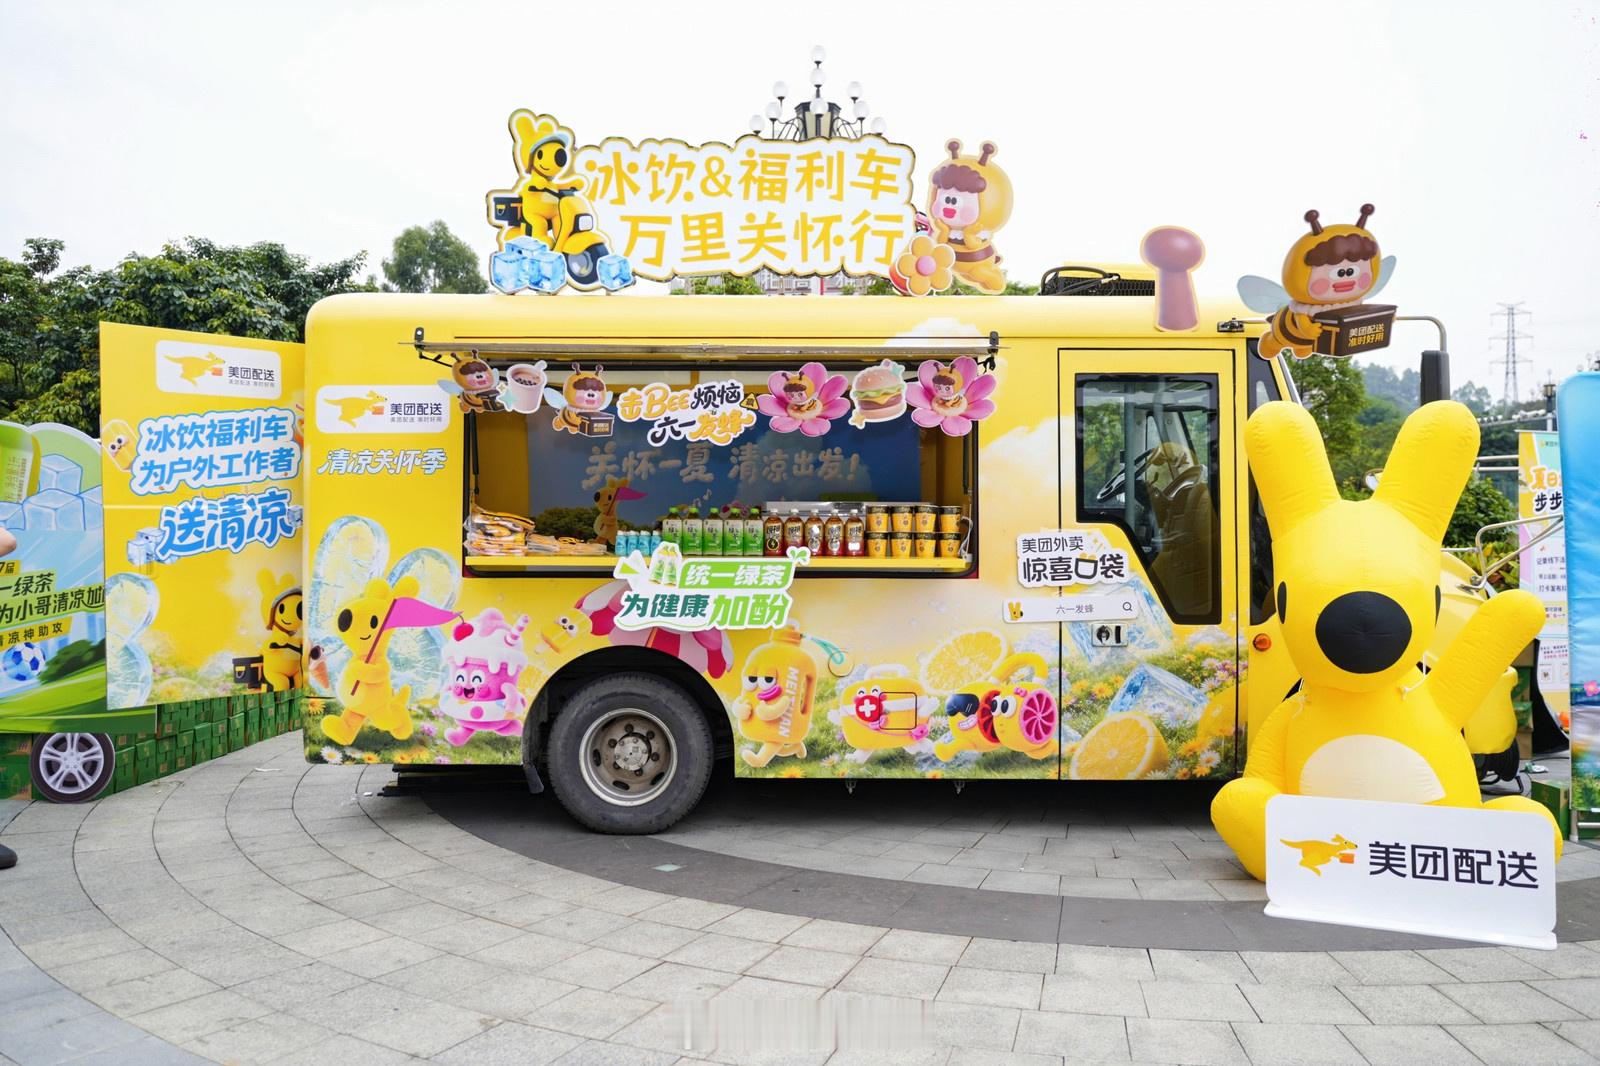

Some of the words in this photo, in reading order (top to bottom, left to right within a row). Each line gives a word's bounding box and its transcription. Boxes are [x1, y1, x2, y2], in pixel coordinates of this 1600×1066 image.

[584, 148, 902, 205] 冰饮&福利车
[619, 209, 904, 266] 万里关怀行
[228, 366, 275, 381] 美团配送
[391, 402, 442, 416] 美团配送
[145, 415, 288, 453] 冰饮福利车
[651, 409, 754, 444] 六一发蜂
[139, 447, 294, 487] 为户外工作者
[316, 448, 447, 474] 清凉关怀季
[582, 441, 715, 490] 关怀一夏
[1531, 467, 1562, 489] 夏日
[160, 491, 293, 554] 送清凉
[1022, 536, 1084, 553] 美团外卖
[685, 564, 787, 586] 统一绿茶
[1023, 553, 1125, 582] 惊喜口袋
[1056, 604, 1093, 614] 六一发蜂
[1369, 841, 1539, 889] 美团配送
